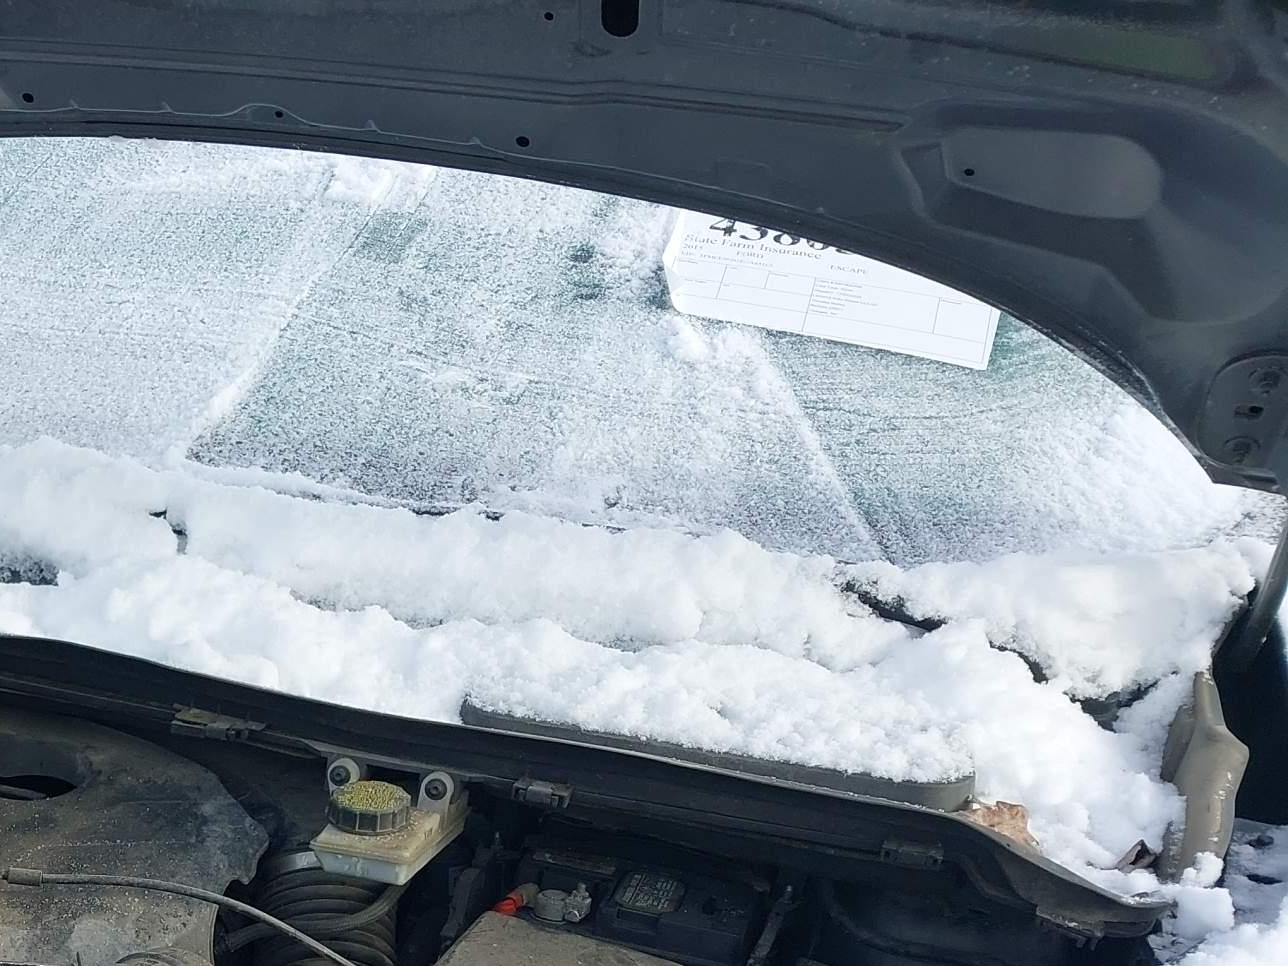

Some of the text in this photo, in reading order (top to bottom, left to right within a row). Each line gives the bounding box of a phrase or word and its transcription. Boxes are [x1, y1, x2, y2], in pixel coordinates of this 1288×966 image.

[685, 233, 720, 246] State
[722, 238, 755, 250] Farm
[759, 243, 823, 260] Insurance
